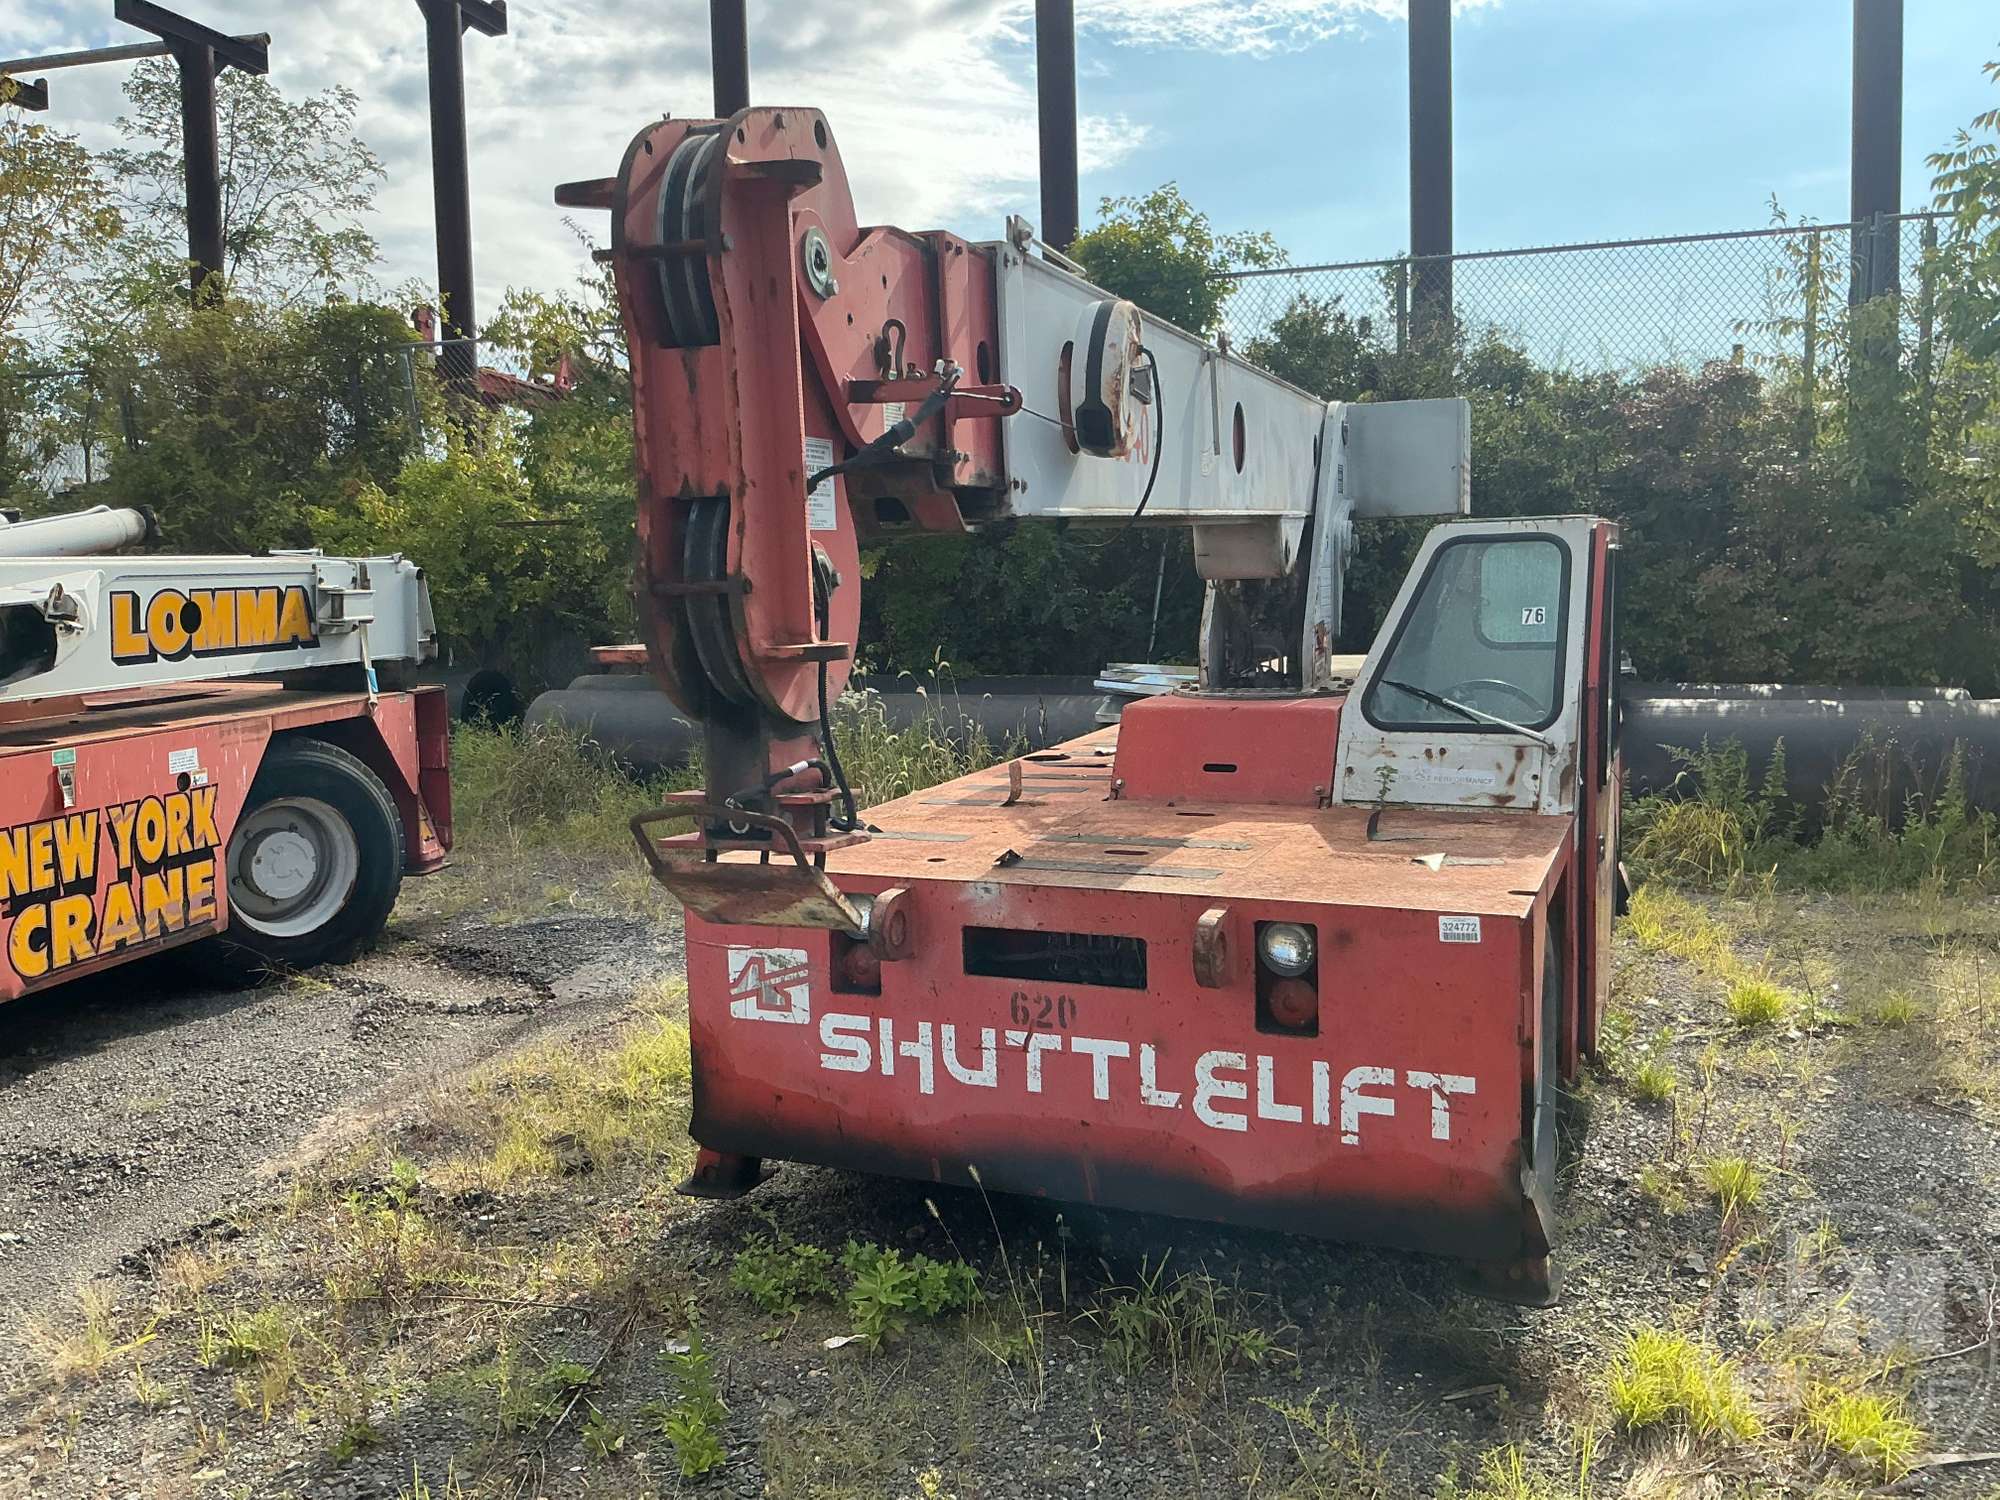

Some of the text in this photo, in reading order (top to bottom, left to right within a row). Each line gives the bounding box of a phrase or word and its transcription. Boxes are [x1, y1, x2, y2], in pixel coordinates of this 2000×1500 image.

[110, 586, 319, 666] LOMMA
[1523, 608, 1544, 624] 76
[0, 809, 101, 898] NEW
[105, 783, 221, 870] YORK
[8, 858, 217, 979] CRANE
[1442, 922, 1478, 932] 324772
[1010, 991, 1077, 1029] 620
[818, 1012, 1477, 1146] SHUTTLELIFT
